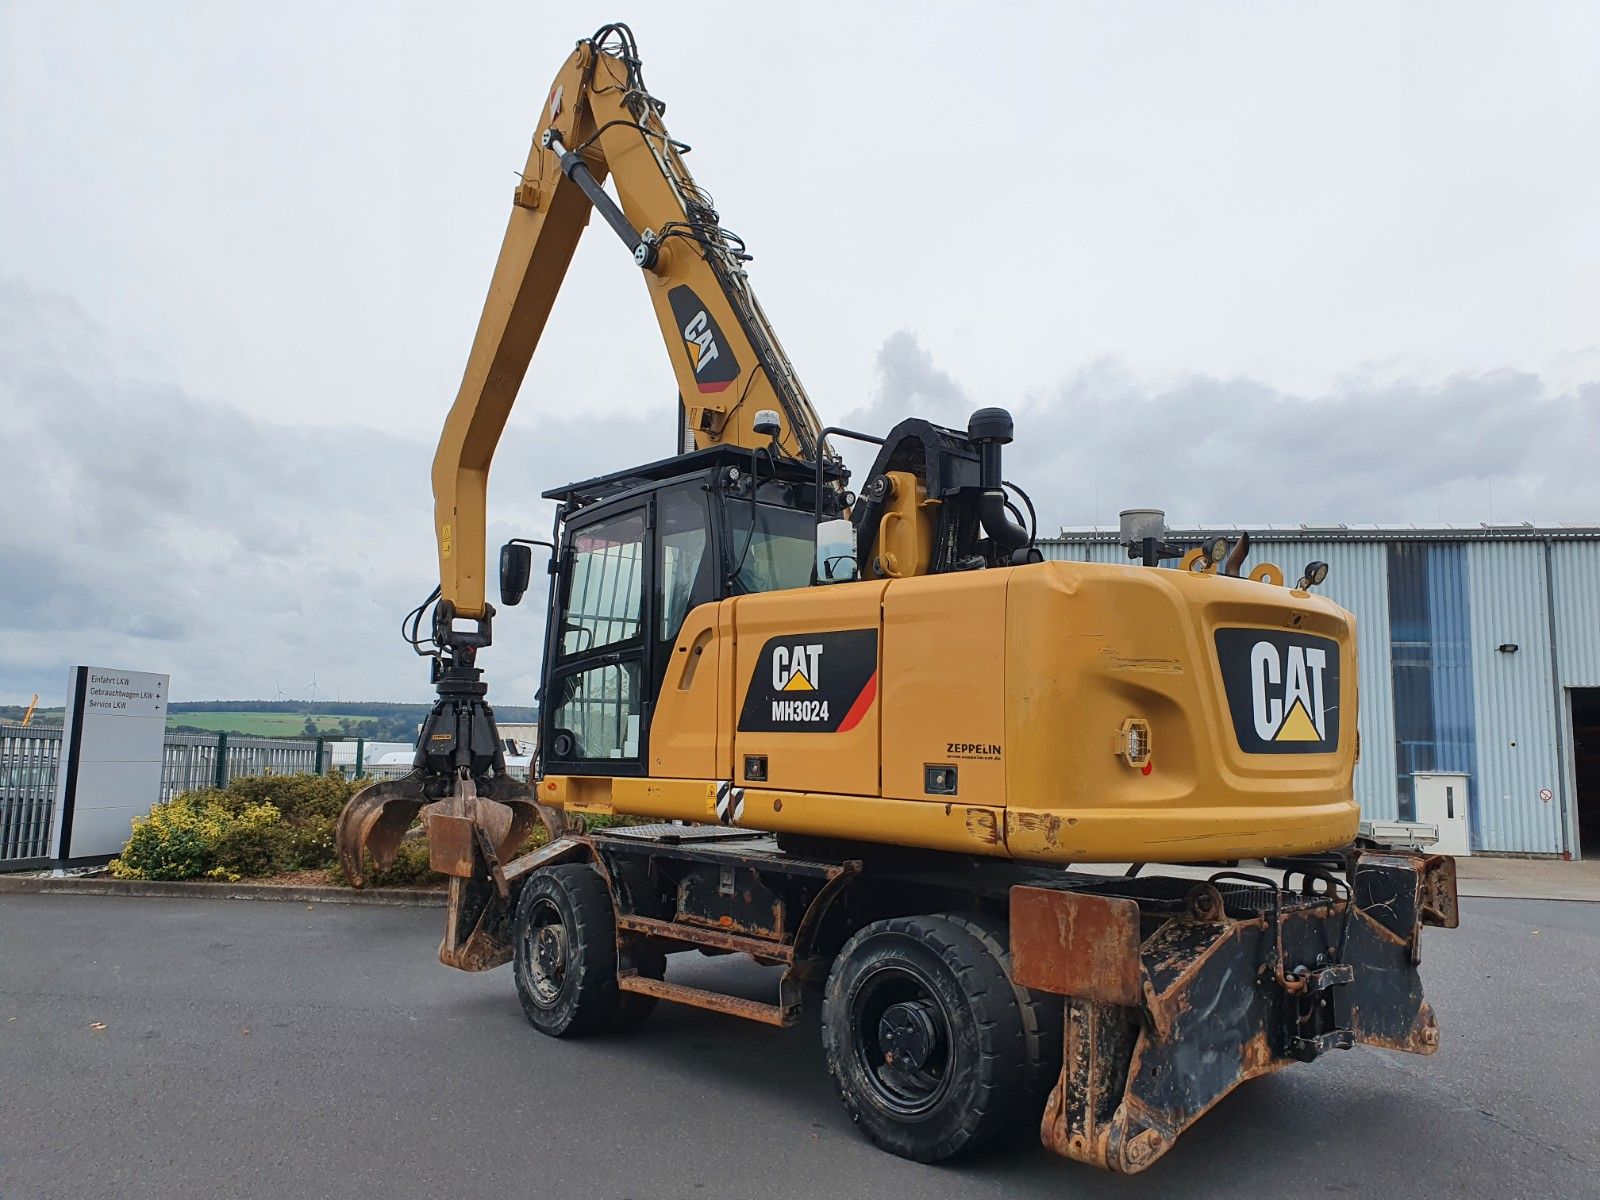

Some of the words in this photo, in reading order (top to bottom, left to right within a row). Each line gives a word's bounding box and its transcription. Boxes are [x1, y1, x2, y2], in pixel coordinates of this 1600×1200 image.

[684, 310, 720, 374] CAT
[772, 644, 824, 691] CAT
[91, 674, 115, 685] Einfahrt
[116, 678, 130, 686] LKW
[90, 687, 140, 700] Gebrauchtwagen
[140, 691, 154, 700] LKW
[1250, 641, 1327, 741] CAT
[89, 700, 112, 709] Service
[113, 701, 127, 710] LKW
[771, 700, 830, 722] MH3024
[946, 743, 1002, 755] ZEPPELIN
